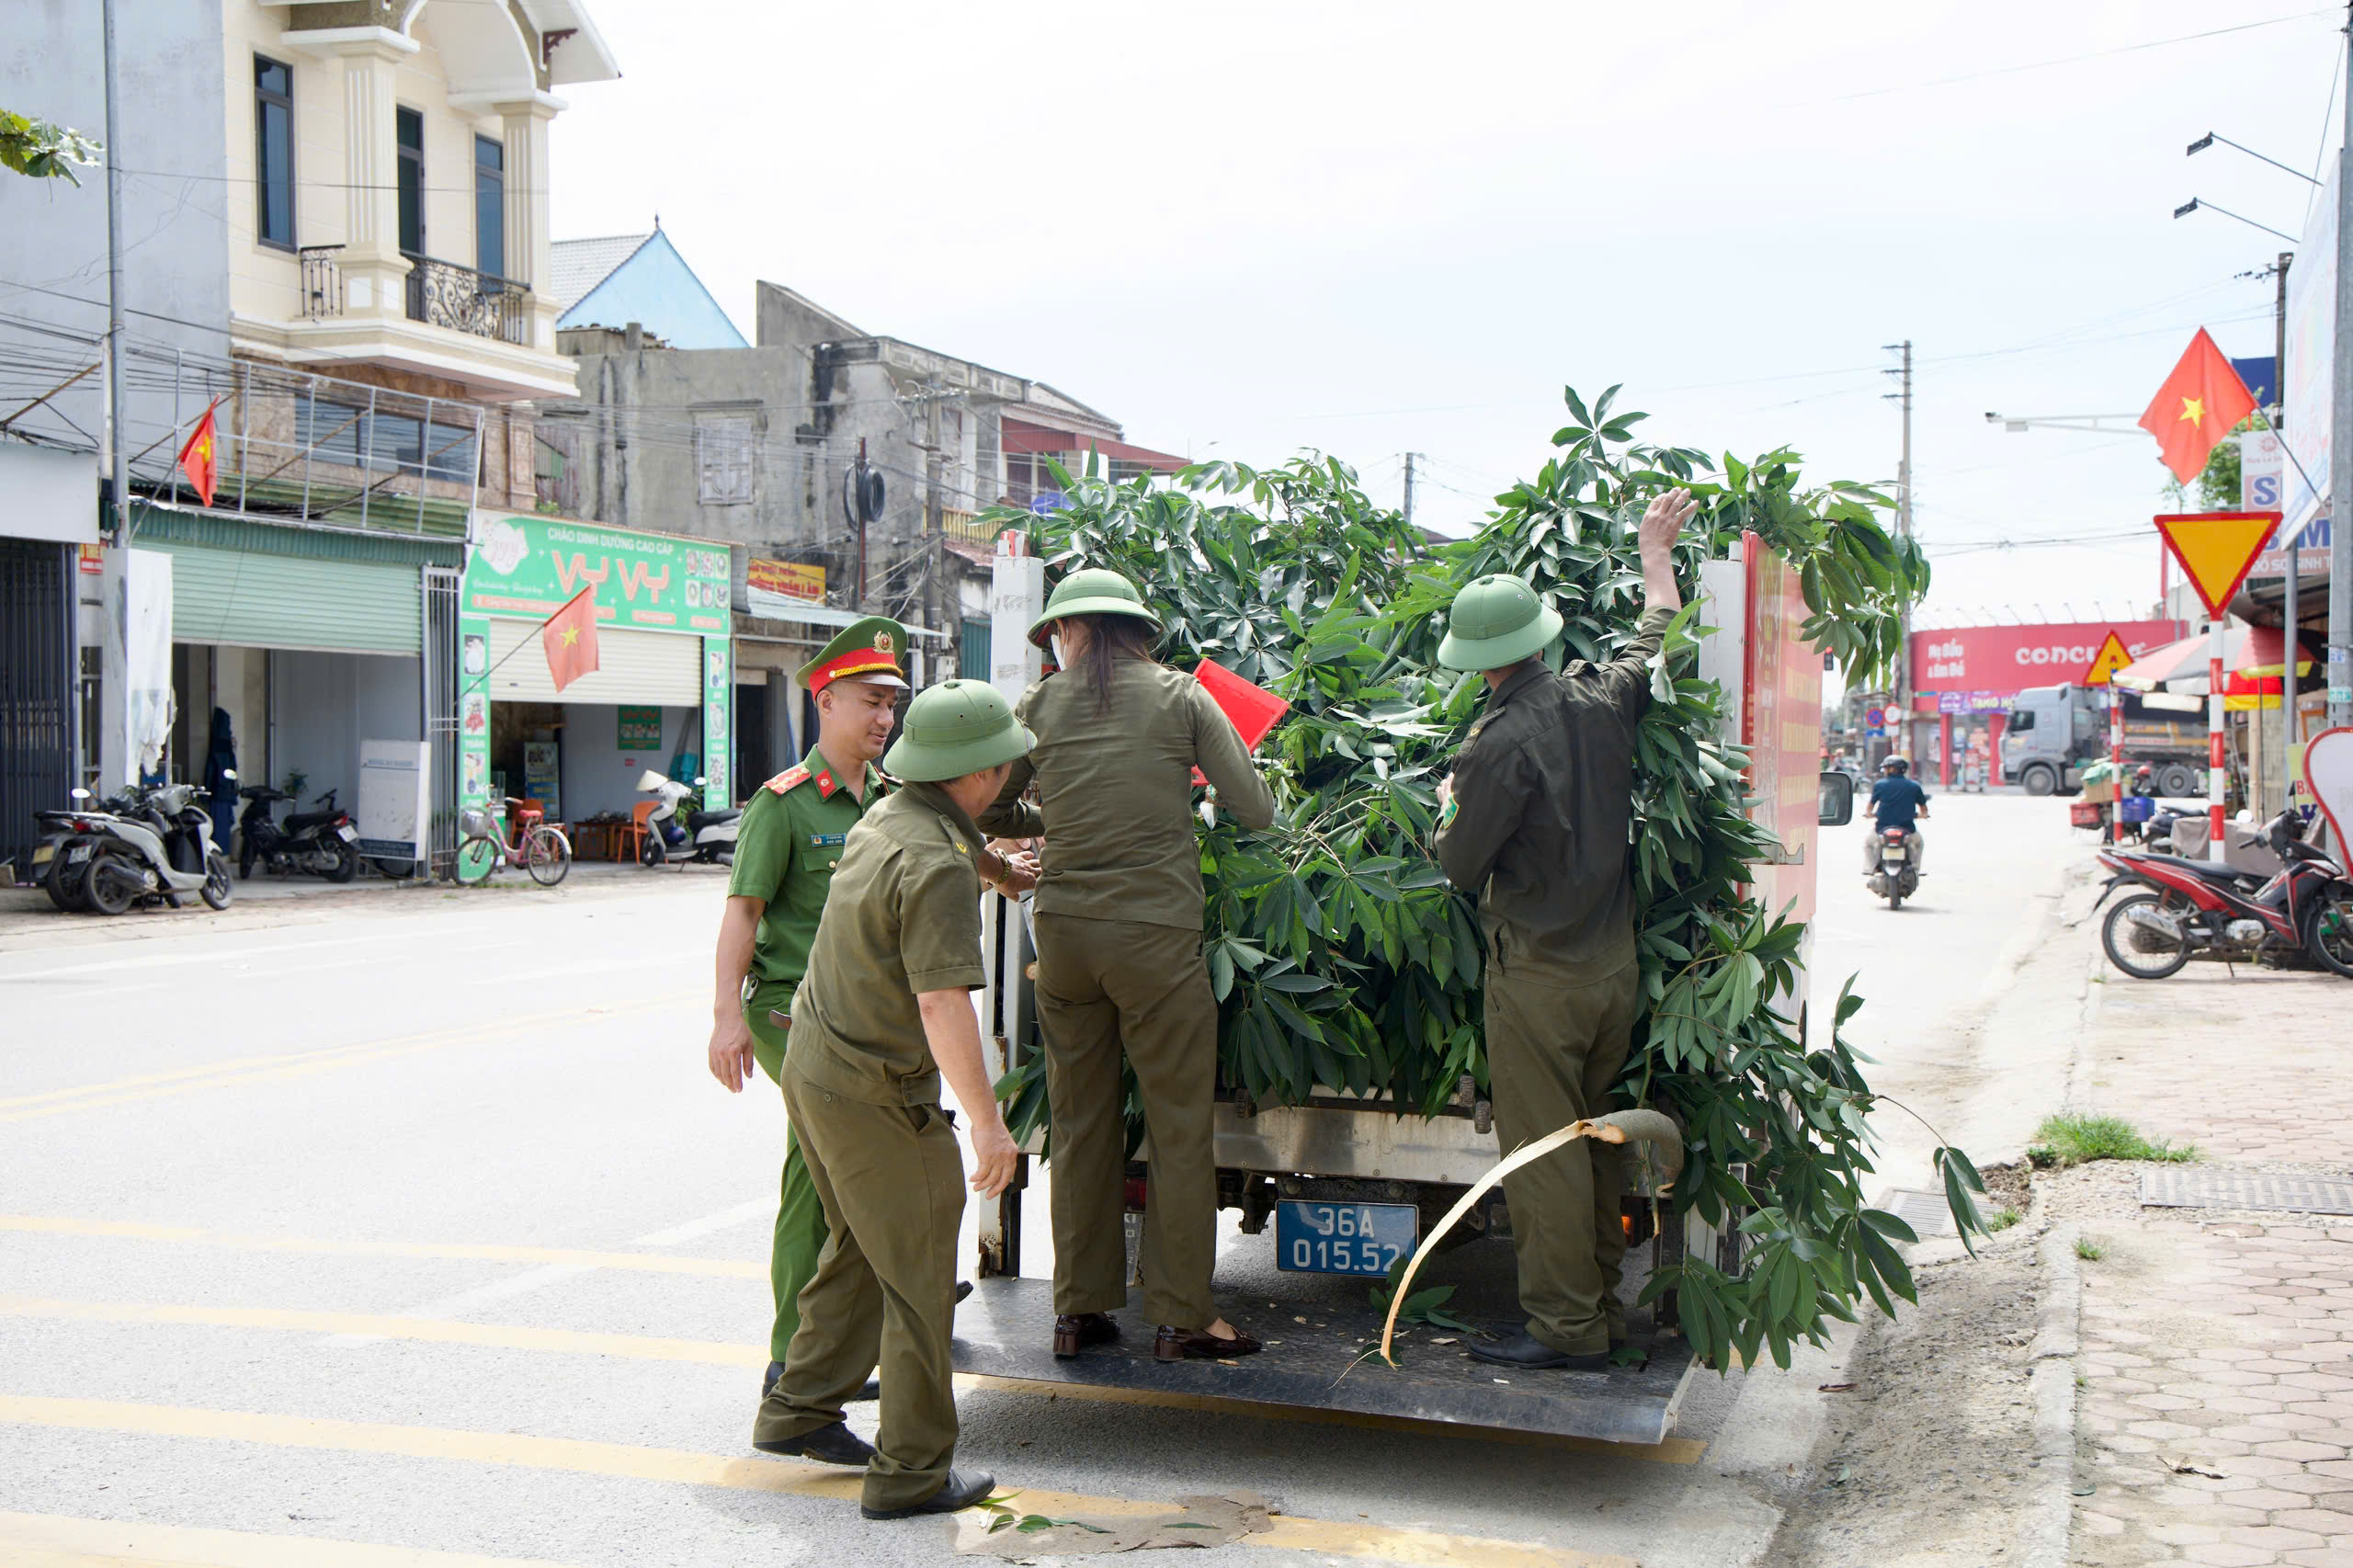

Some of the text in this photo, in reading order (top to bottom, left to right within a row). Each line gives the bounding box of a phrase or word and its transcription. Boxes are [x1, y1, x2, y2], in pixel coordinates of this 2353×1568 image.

[636, 539, 655, 553] CAO
[1317, 1208, 1374, 1238] 36A
[1293, 1239, 1400, 1272] 015.52
